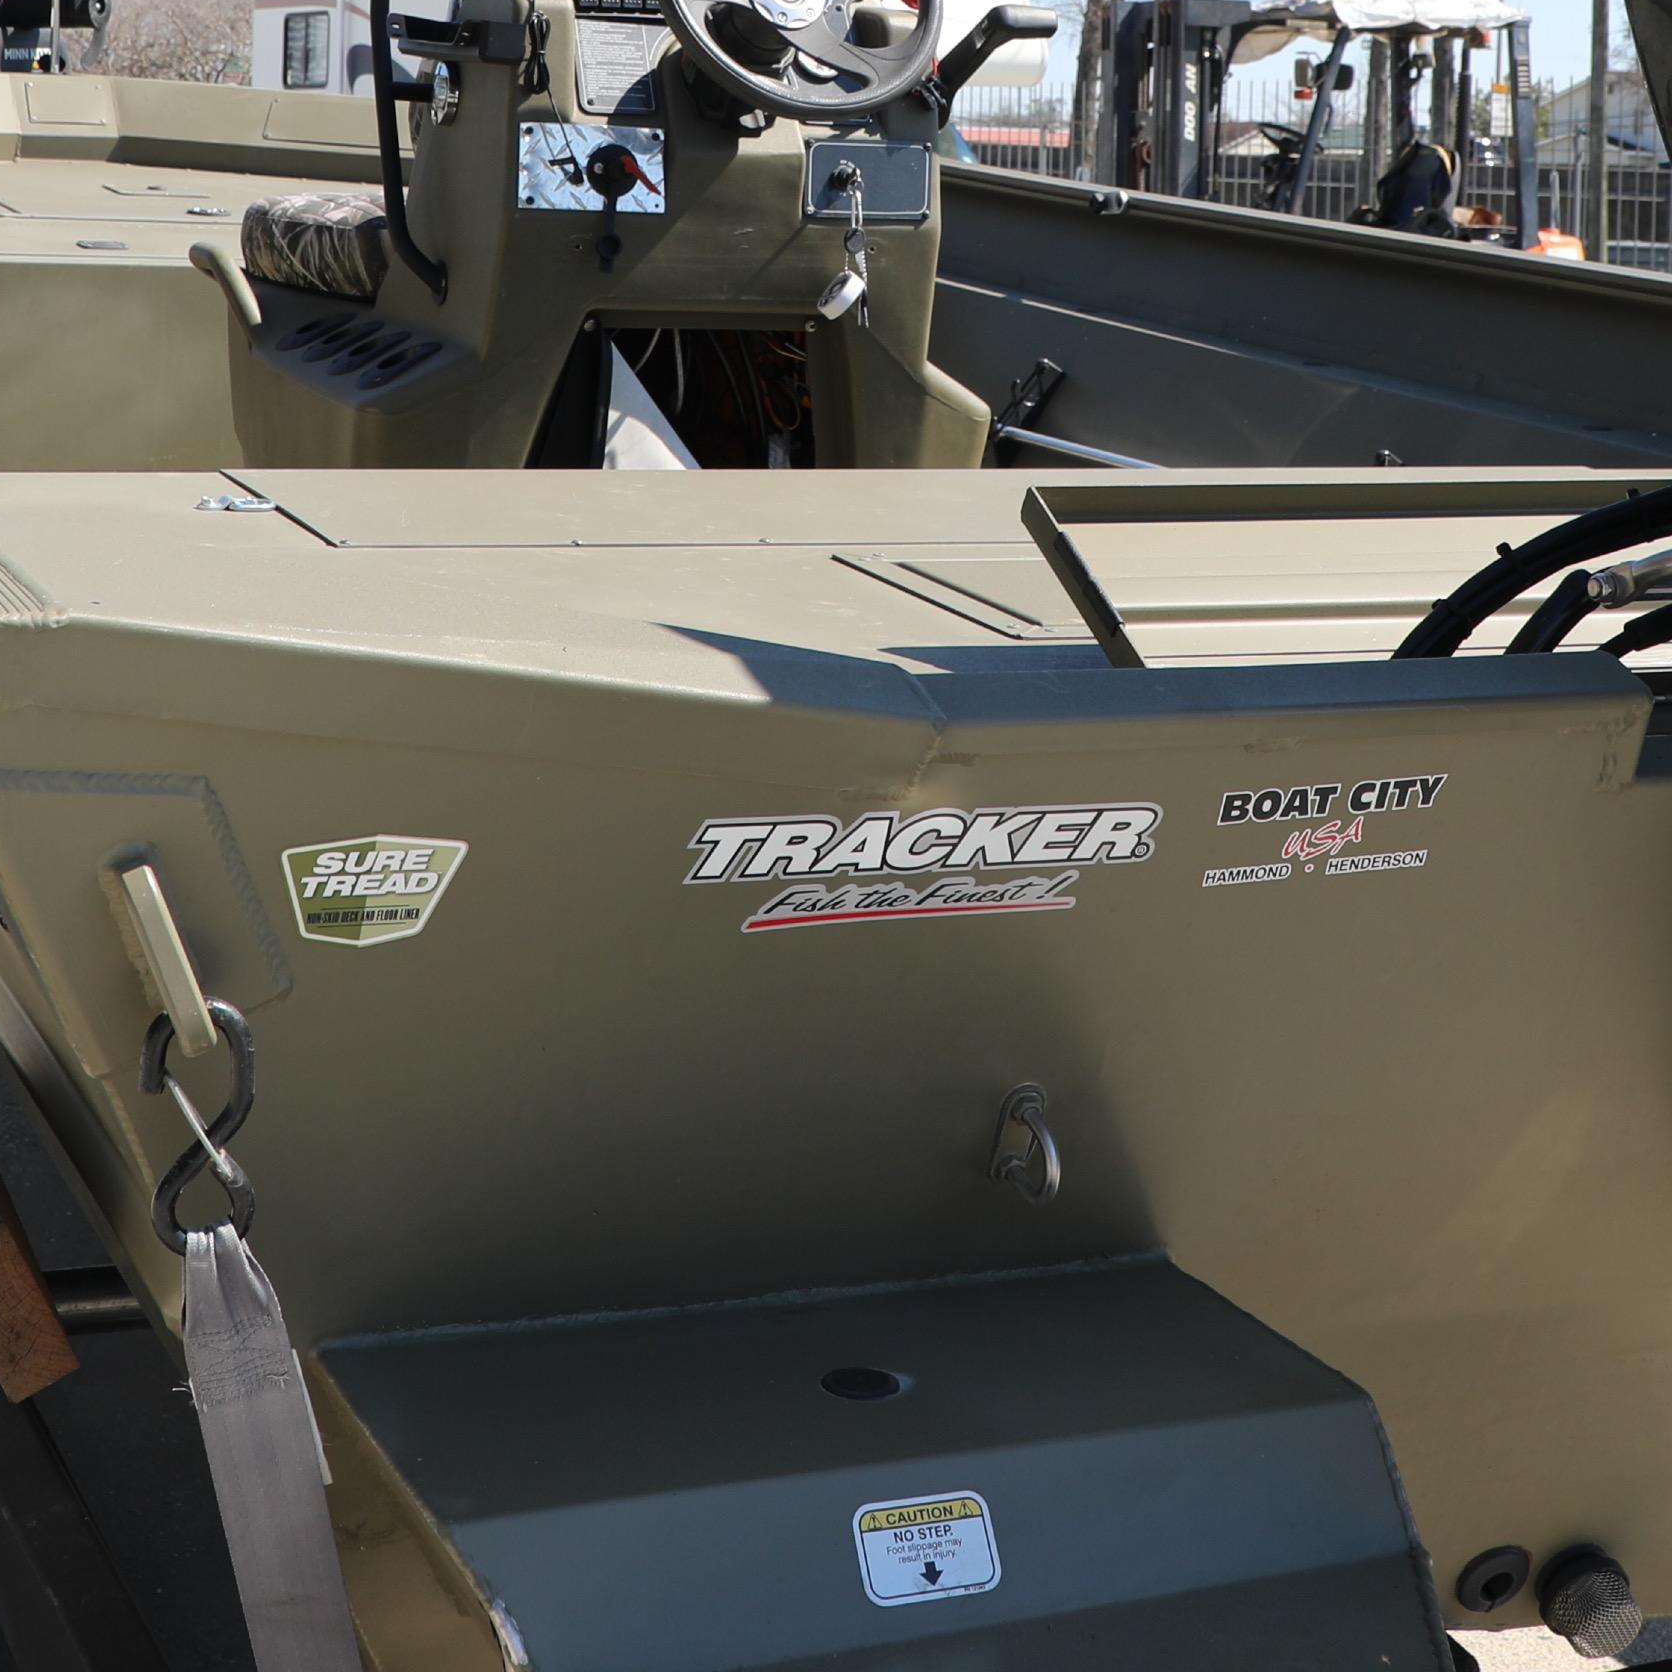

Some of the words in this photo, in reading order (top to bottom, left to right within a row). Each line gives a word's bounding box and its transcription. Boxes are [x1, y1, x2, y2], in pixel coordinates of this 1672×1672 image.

[4, 47, 29, 60] MINN
[1218, 786, 1340, 824] BOAT
[1349, 775, 1445, 812] CITY
[1282, 817, 1363, 859] USA
[313, 849, 434, 874] SURE
[1204, 864, 1291, 886] HAMMOND
[1327, 851, 1426, 874] HENDERSON
[301, 872, 438, 898] TREAD
[765, 888, 846, 915] Fish
[856, 888, 912, 910] the
[307, 912, 340, 924] NON-SKID
[341, 911, 359, 923] DECK
[361, 910, 376, 922] AND
[377, 909, 398, 921] FLOOR
[400, 908, 420, 920] LINER
[886, 1506, 954, 1525] CAUTION
[894, 1531, 914, 1543] NO
[917, 1525, 953, 1540] STEP.
[887, 1544, 906, 1555] Foot
[908, 1540, 943, 1555] slippage
[945, 1537, 962, 1548] may
[898, 1553, 921, 1564] result
[923, 1552, 931, 1561] in
